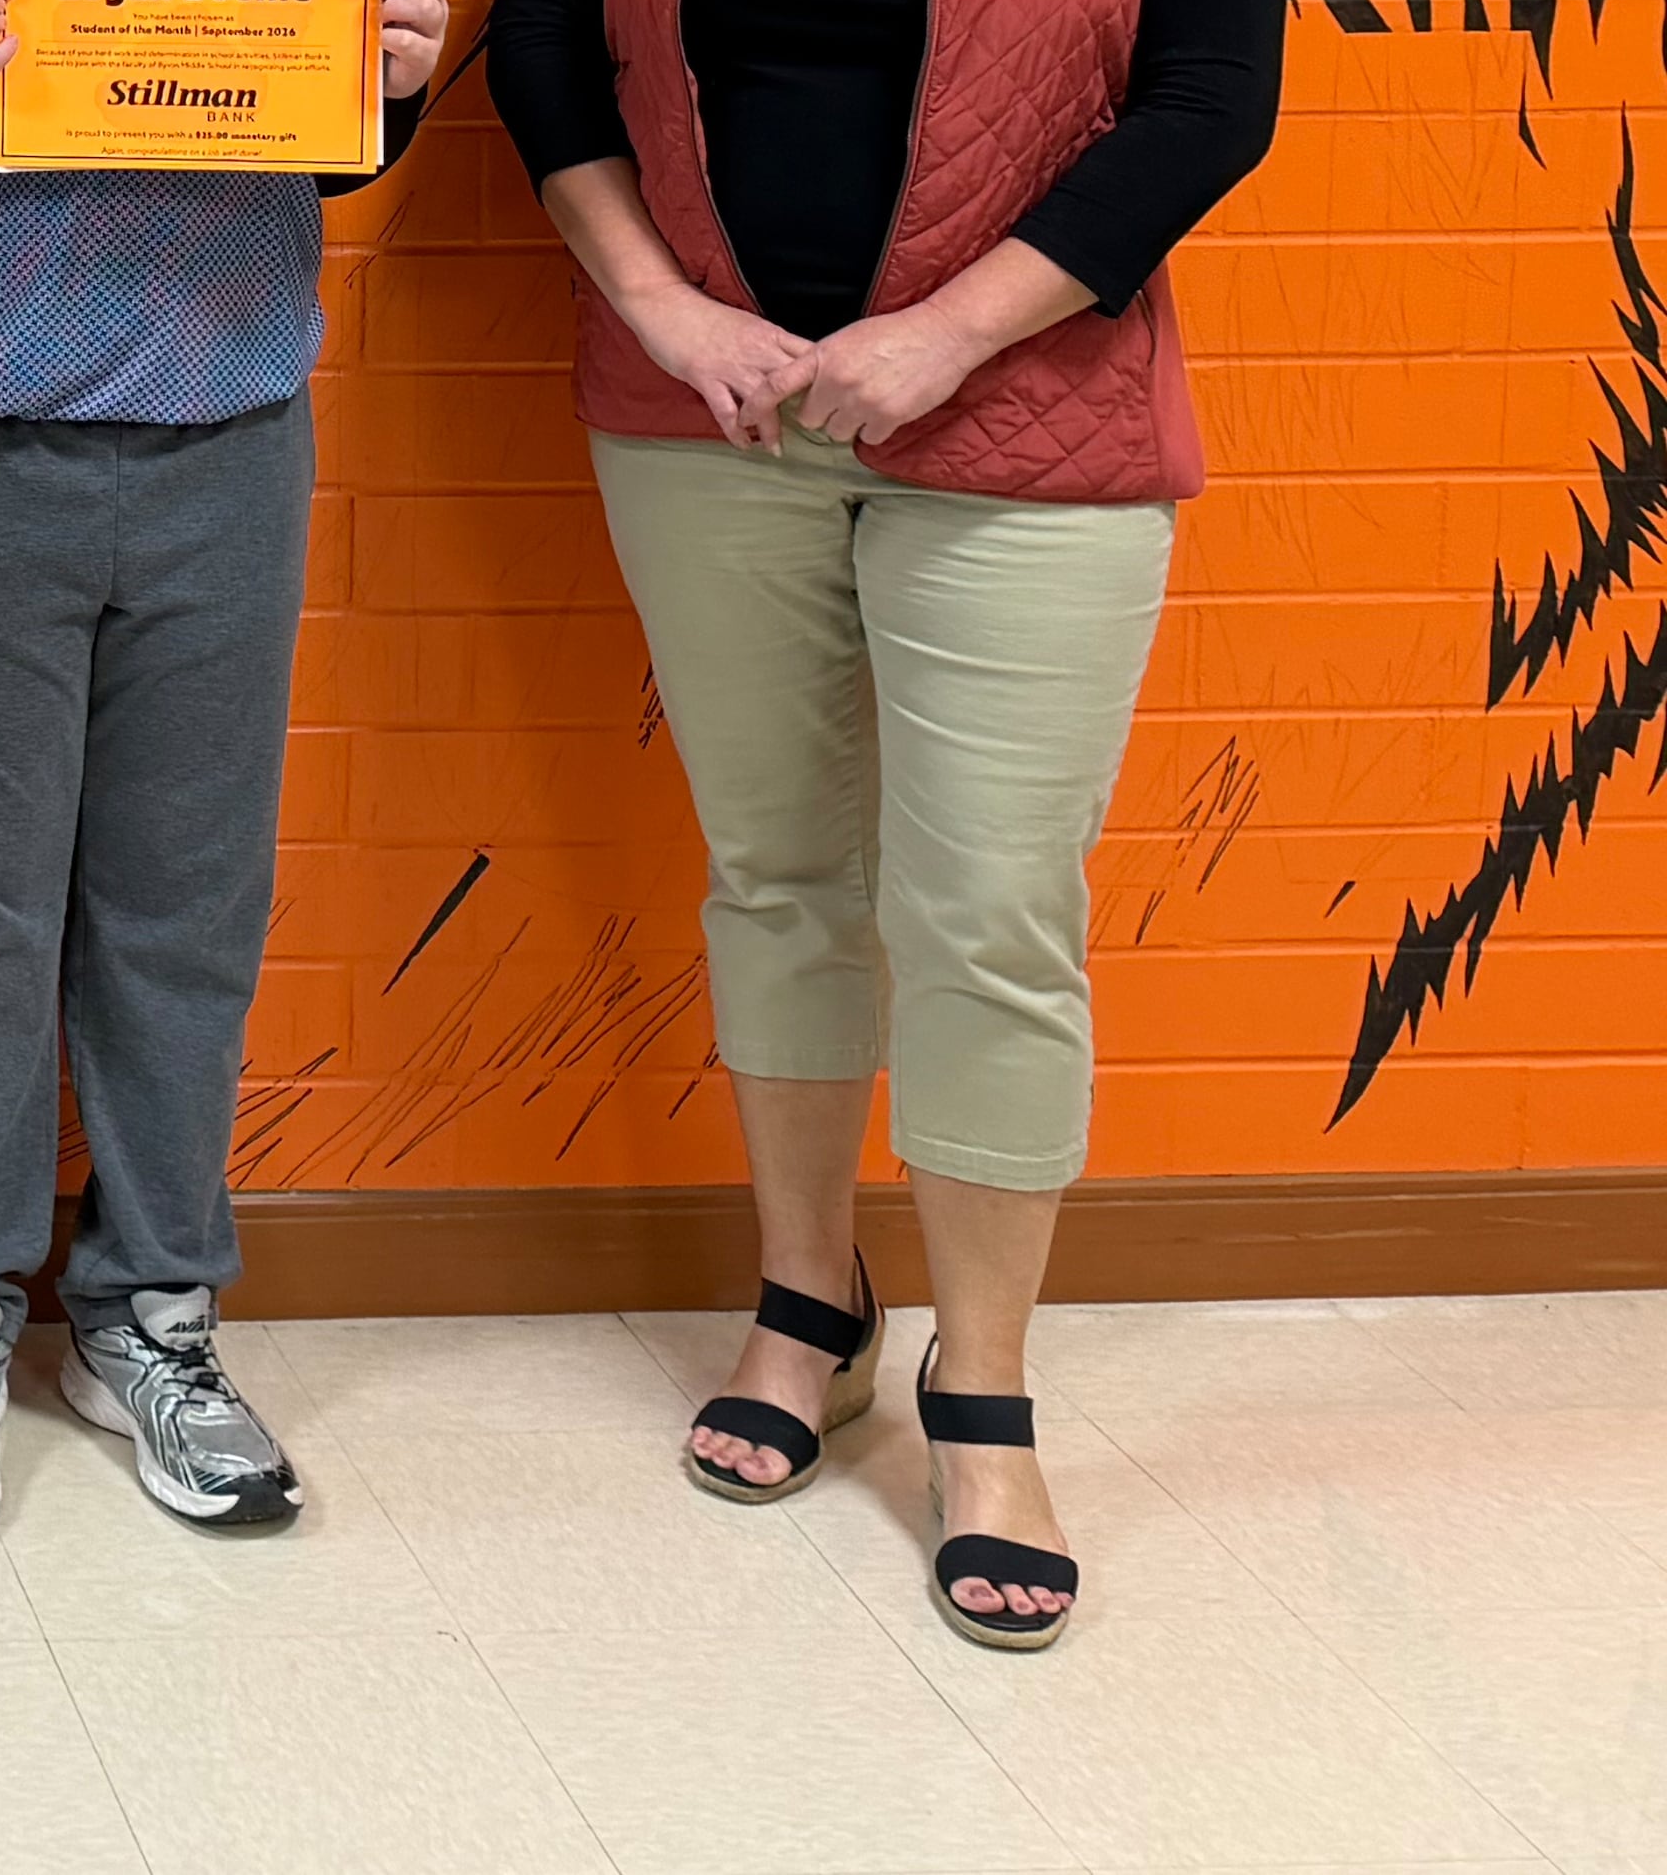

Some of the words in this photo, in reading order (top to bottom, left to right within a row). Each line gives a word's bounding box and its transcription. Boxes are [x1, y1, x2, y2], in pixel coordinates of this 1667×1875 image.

[70, 23, 115, 34] Student
[118, 24, 130, 34] of
[133, 24, 152, 34] the
[154, 24, 191, 35] Month
[201, 25, 263, 37] September
[266, 26, 296, 37] 2026
[106, 78, 257, 108] Stillman
[206, 110, 254, 122] BANK
